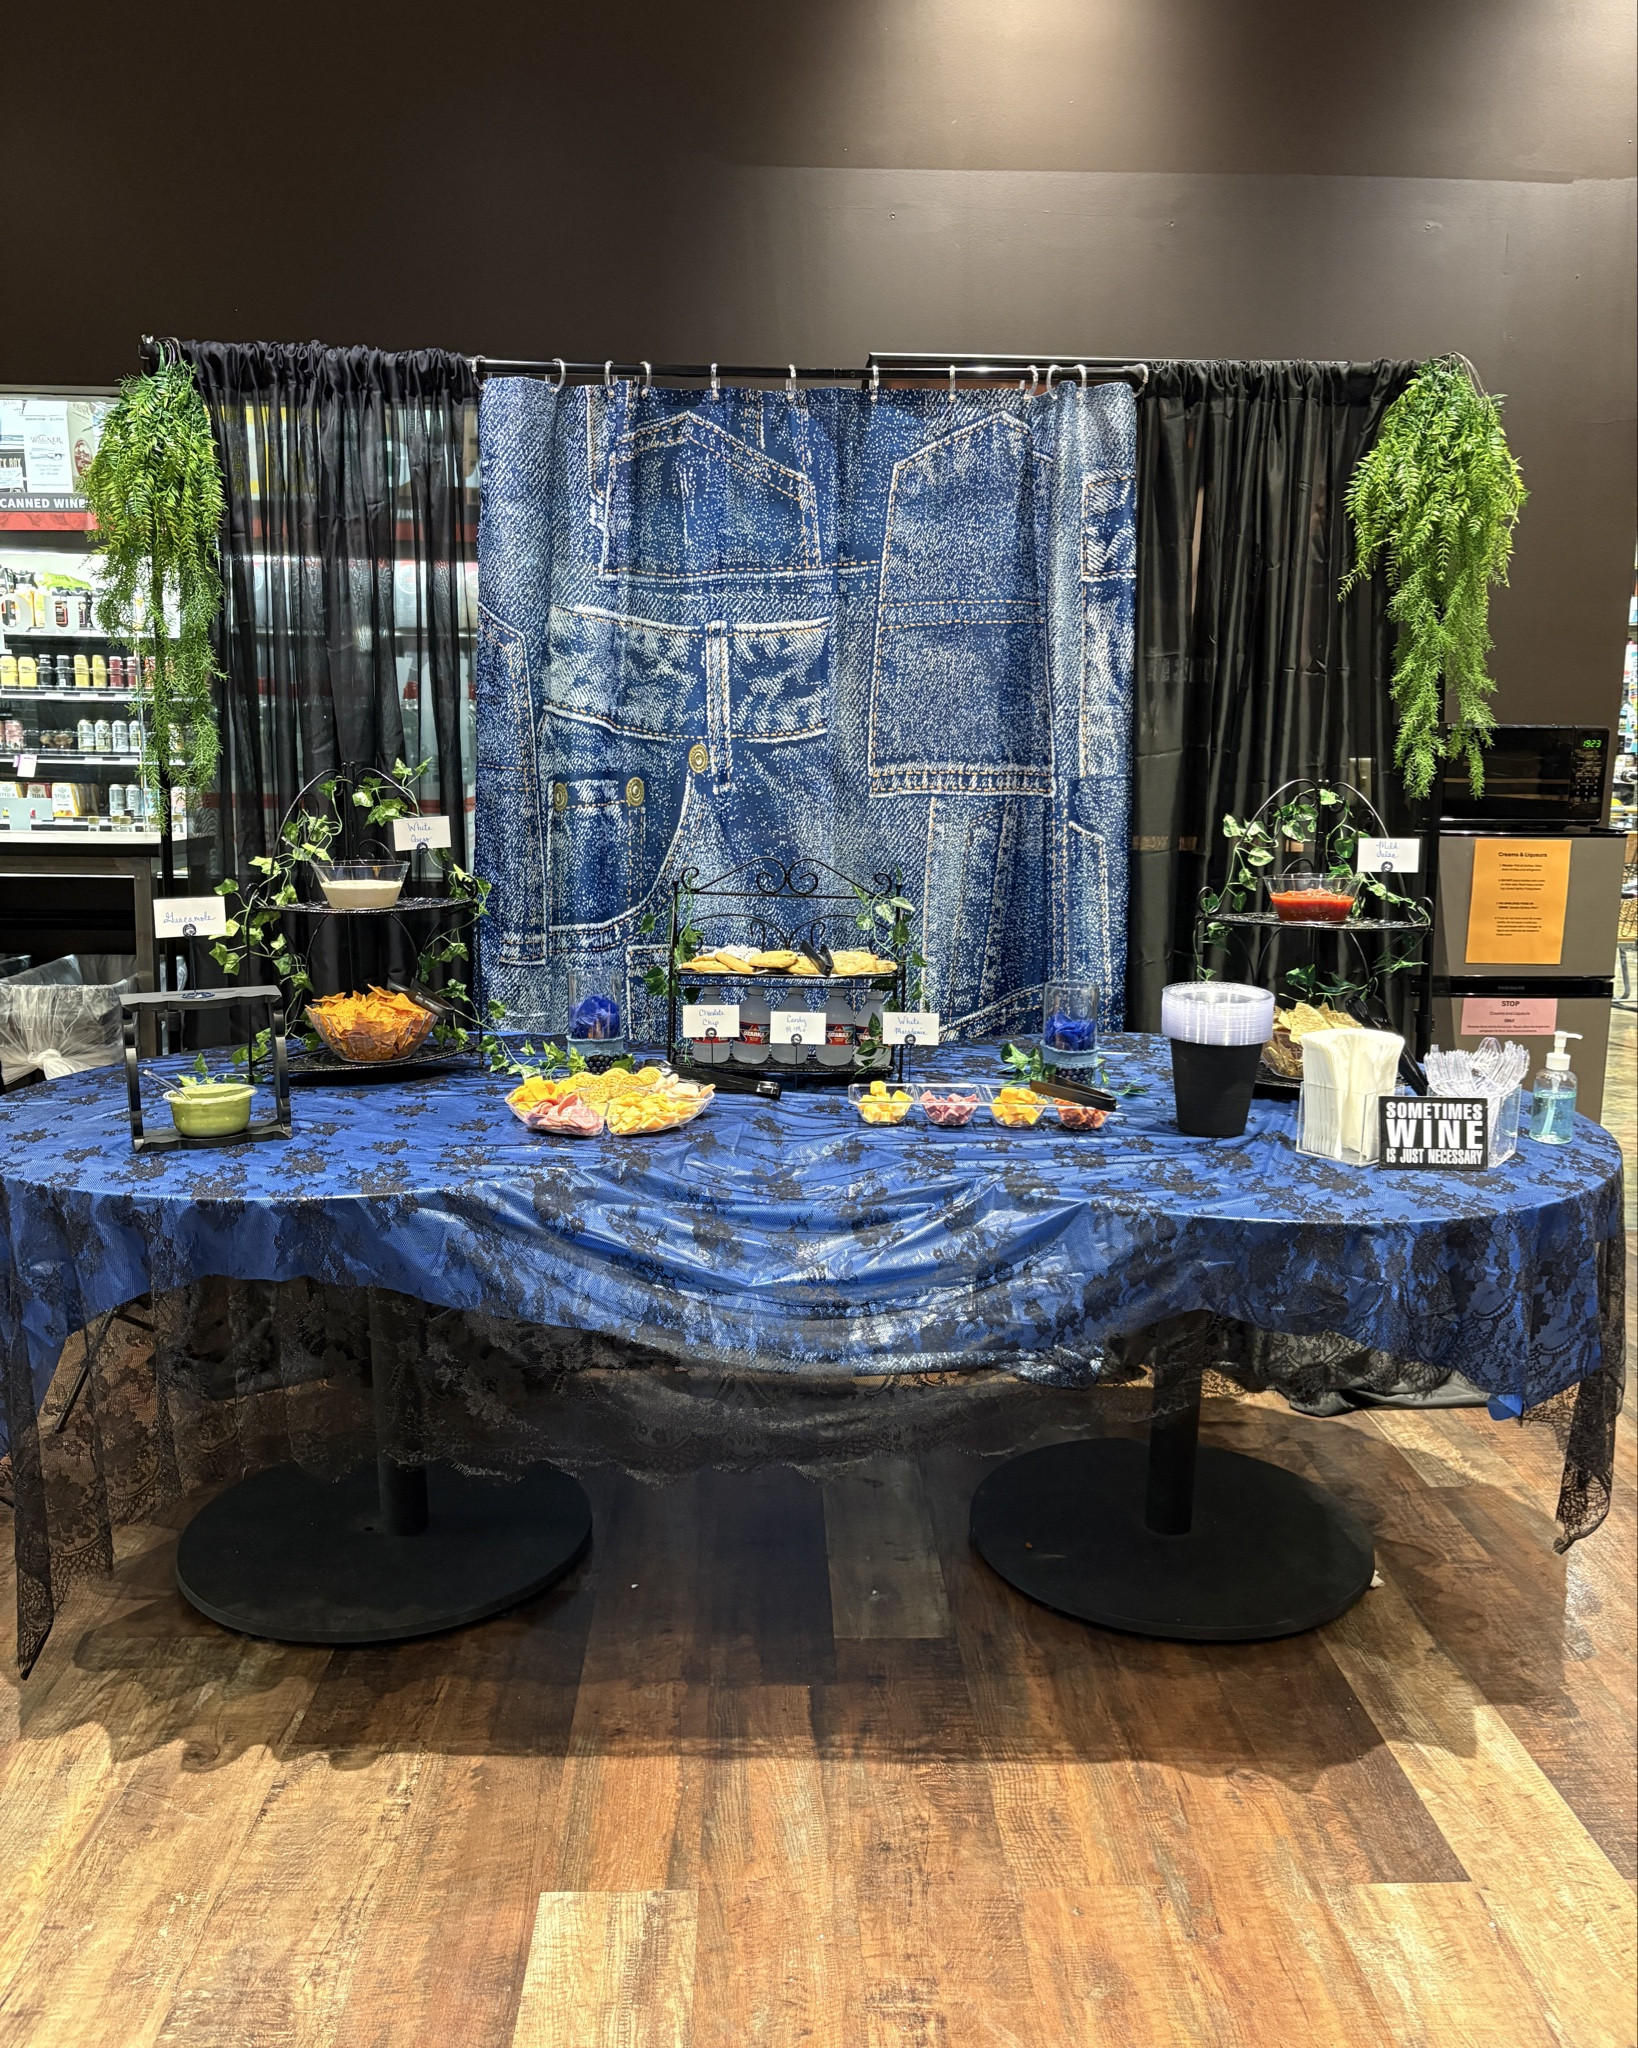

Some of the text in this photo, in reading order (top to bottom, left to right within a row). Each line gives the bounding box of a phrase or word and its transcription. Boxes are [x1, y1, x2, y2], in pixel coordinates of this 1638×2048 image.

[0, 498, 50, 508] CANNED
[407, 821, 432, 832] White
[163, 911, 217, 924] Guacamole
[897, 1015, 922, 1025] White
[1386, 1101, 1483, 1120] SOMETIMES
[1386, 1119, 1483, 1149] WINE
[1386, 1147, 1483, 1165] IS JUST NECESSARY
